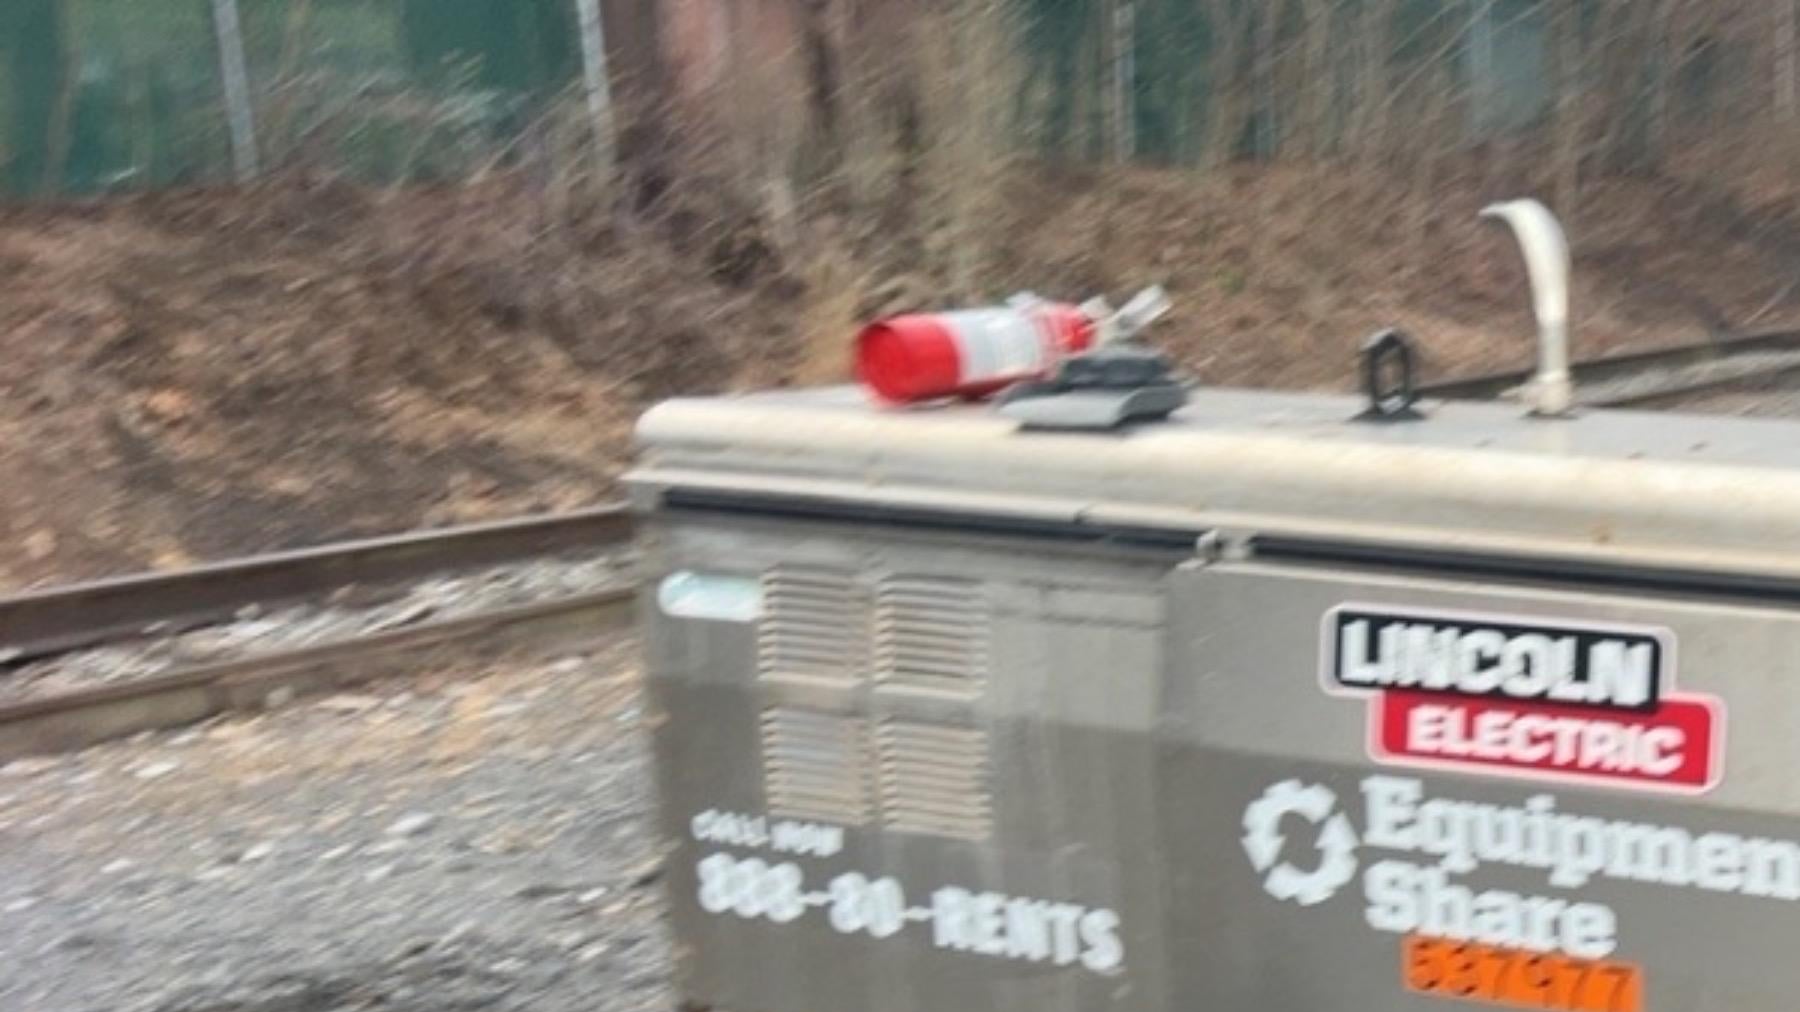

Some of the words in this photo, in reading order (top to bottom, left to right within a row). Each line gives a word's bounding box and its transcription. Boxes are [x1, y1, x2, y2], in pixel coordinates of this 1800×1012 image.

[1338, 617, 1656, 706] LINCOLN
[1405, 704, 1686, 775] ELECTRIC
[1363, 859, 1618, 959] Share
